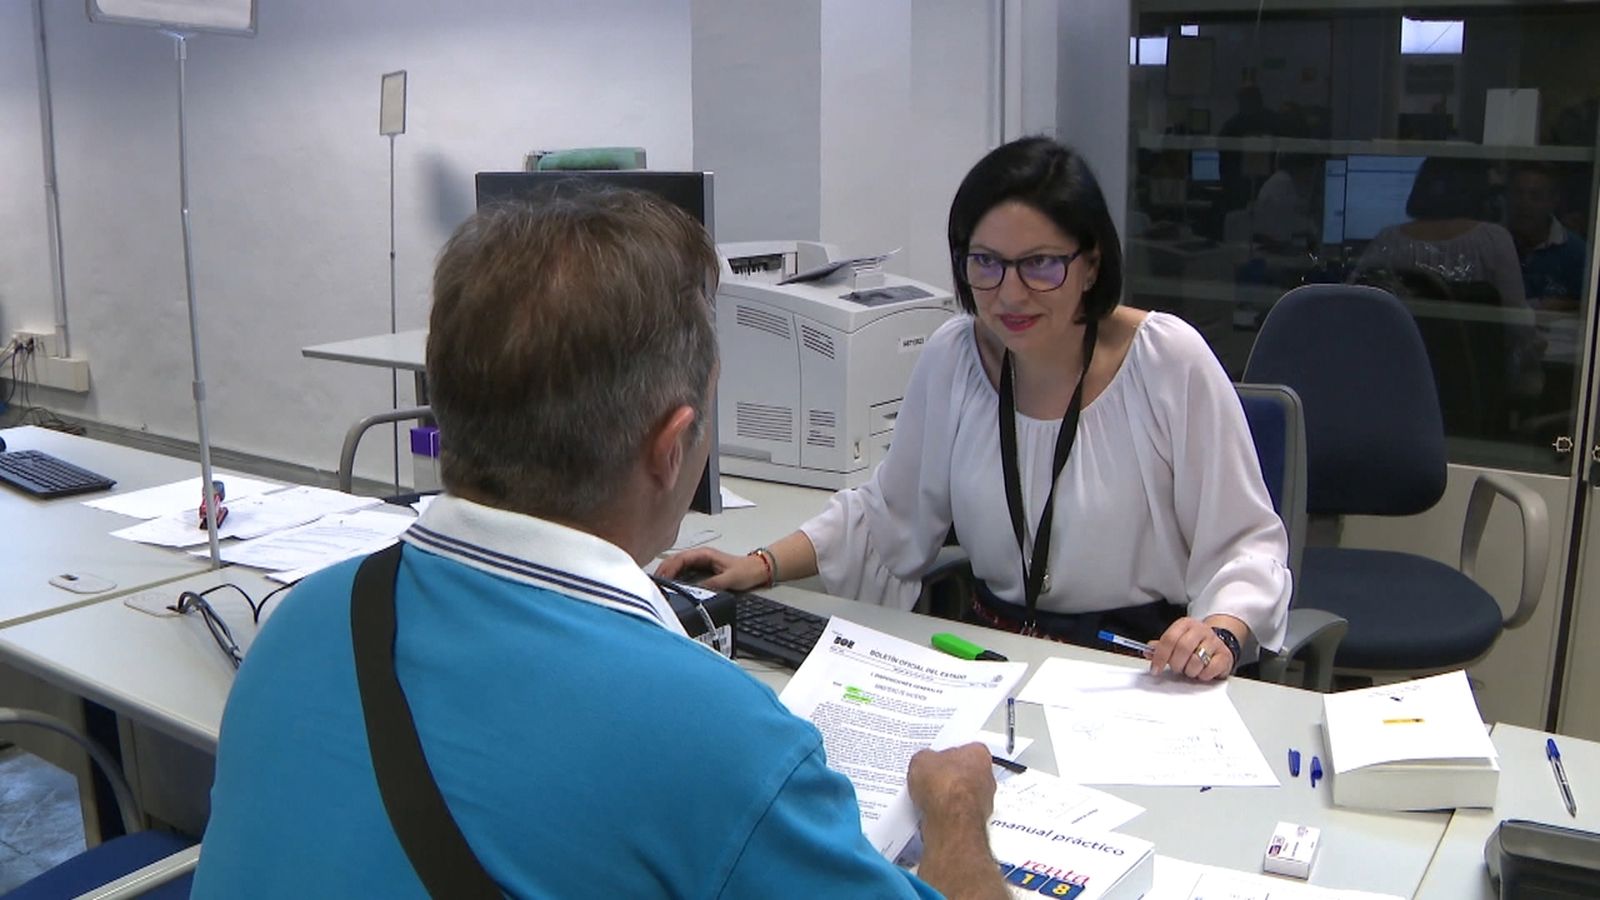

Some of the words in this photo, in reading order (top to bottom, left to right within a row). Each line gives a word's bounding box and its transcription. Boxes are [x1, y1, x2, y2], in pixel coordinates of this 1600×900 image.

[833, 635, 855, 650] BOE
[869, 649, 898, 664] BOLETÍN
[899, 659, 925, 672] OFICIAL
[925, 667, 939, 676] DEL
[940, 670, 967, 680] ESTADO
[991, 819, 1053, 838] manual
[1051, 832, 1125, 857] práctico
[1022, 859, 1091, 885] renta
